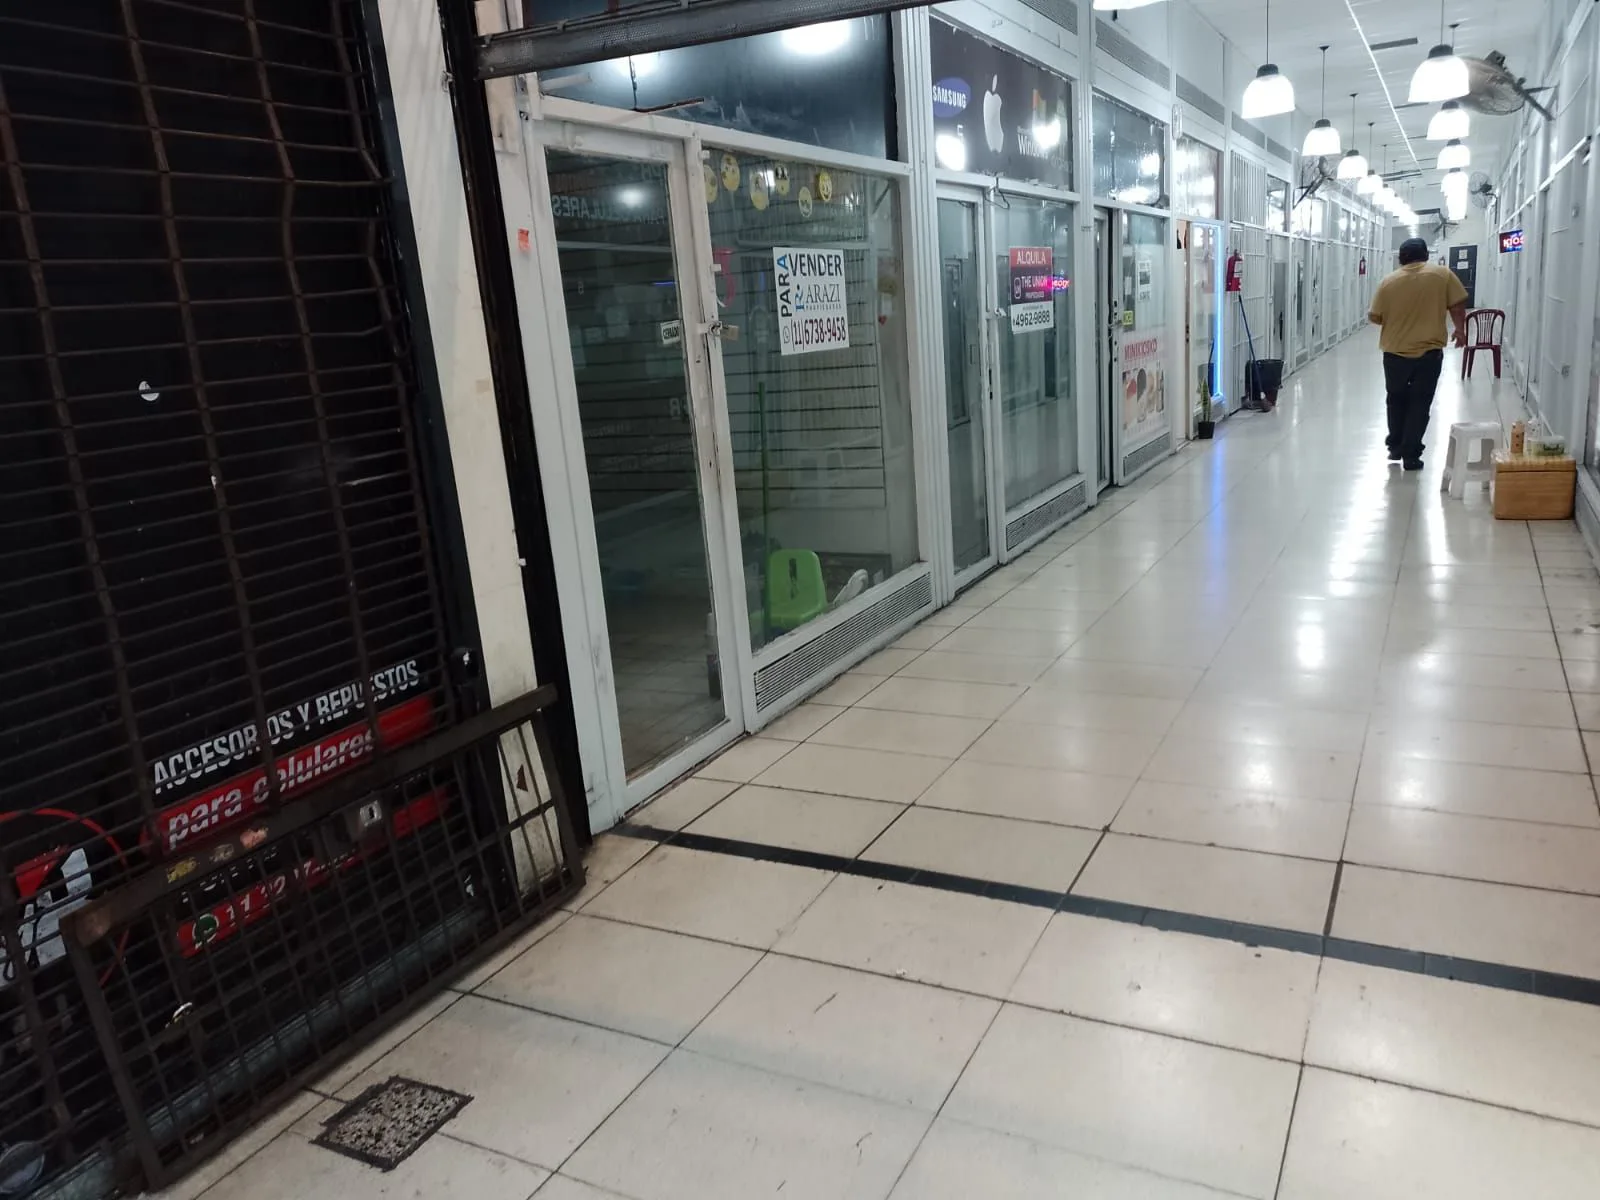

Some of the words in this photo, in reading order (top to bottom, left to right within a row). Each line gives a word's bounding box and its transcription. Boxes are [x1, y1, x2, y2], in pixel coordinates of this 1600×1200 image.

[933, 85, 967, 109] SAMSUNG
[789, 253, 843, 277] VENDER
[1017, 250, 1046, 265] ALQUILA
[776, 253, 792, 318] PARA
[806, 283, 841, 304] ARAZI
[154, 710, 295, 795] ACCESOROS
[297, 702, 311, 732] Y
[168, 786, 243, 851] para
